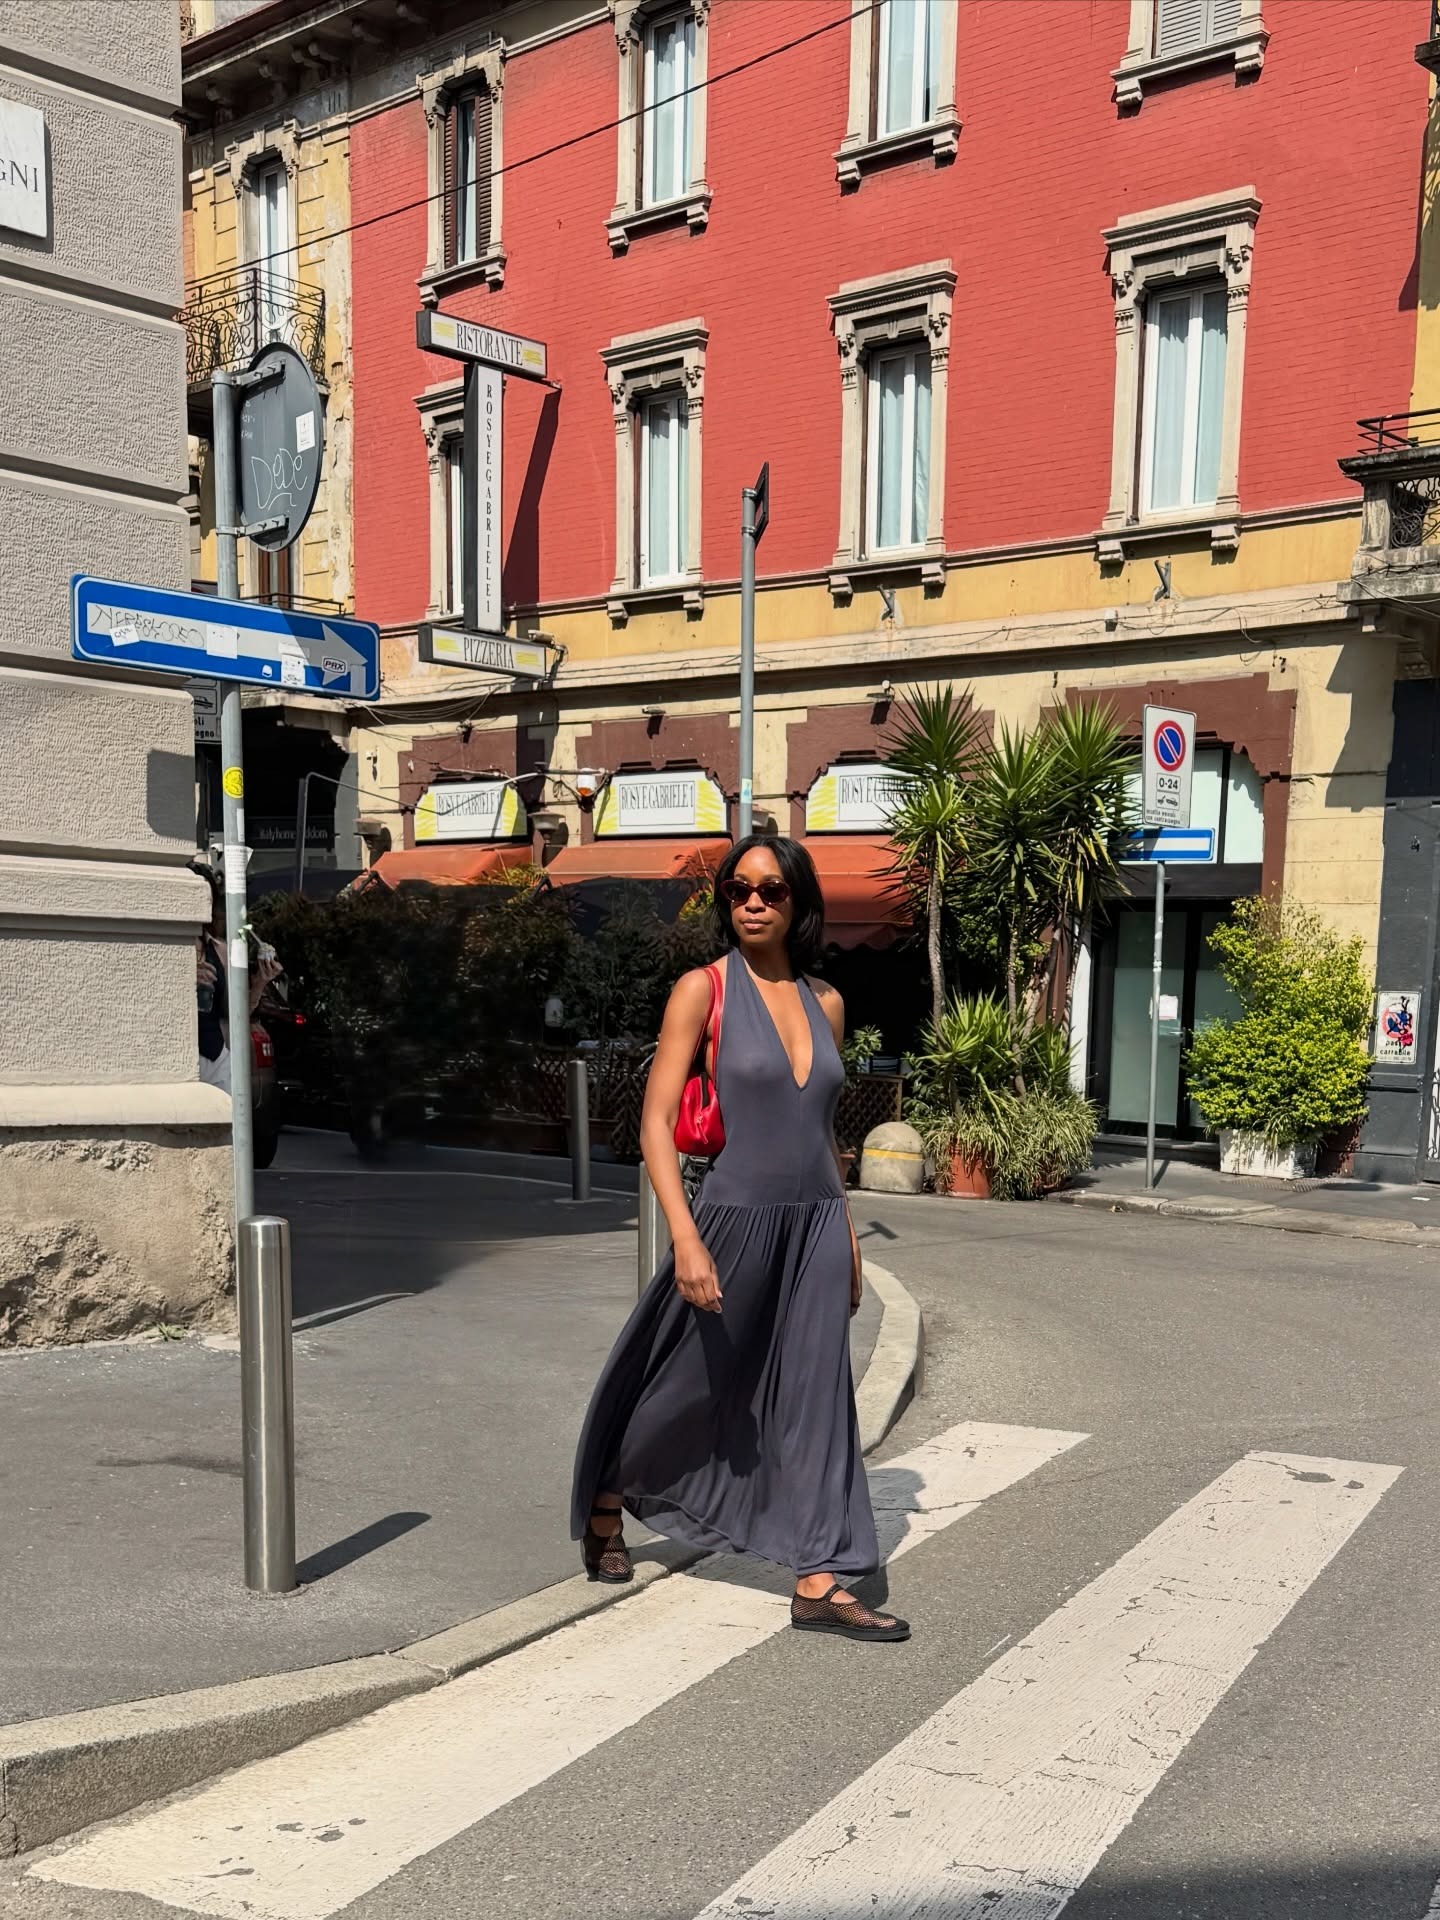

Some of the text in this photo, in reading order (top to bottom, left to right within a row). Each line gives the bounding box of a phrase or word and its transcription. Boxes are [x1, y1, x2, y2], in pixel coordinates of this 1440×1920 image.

[456, 322, 523, 366] RISTORANTE
[463, 636, 515, 669] PIZZERIA
[621, 785, 641, 810] ROSY
[642, 786, 648, 809] E
[649, 783, 689, 809] GABRIELE
[841, 777, 863, 804] ROSY
[866, 776, 873, 803] E
[1159, 777, 1178, 790] 0-24
